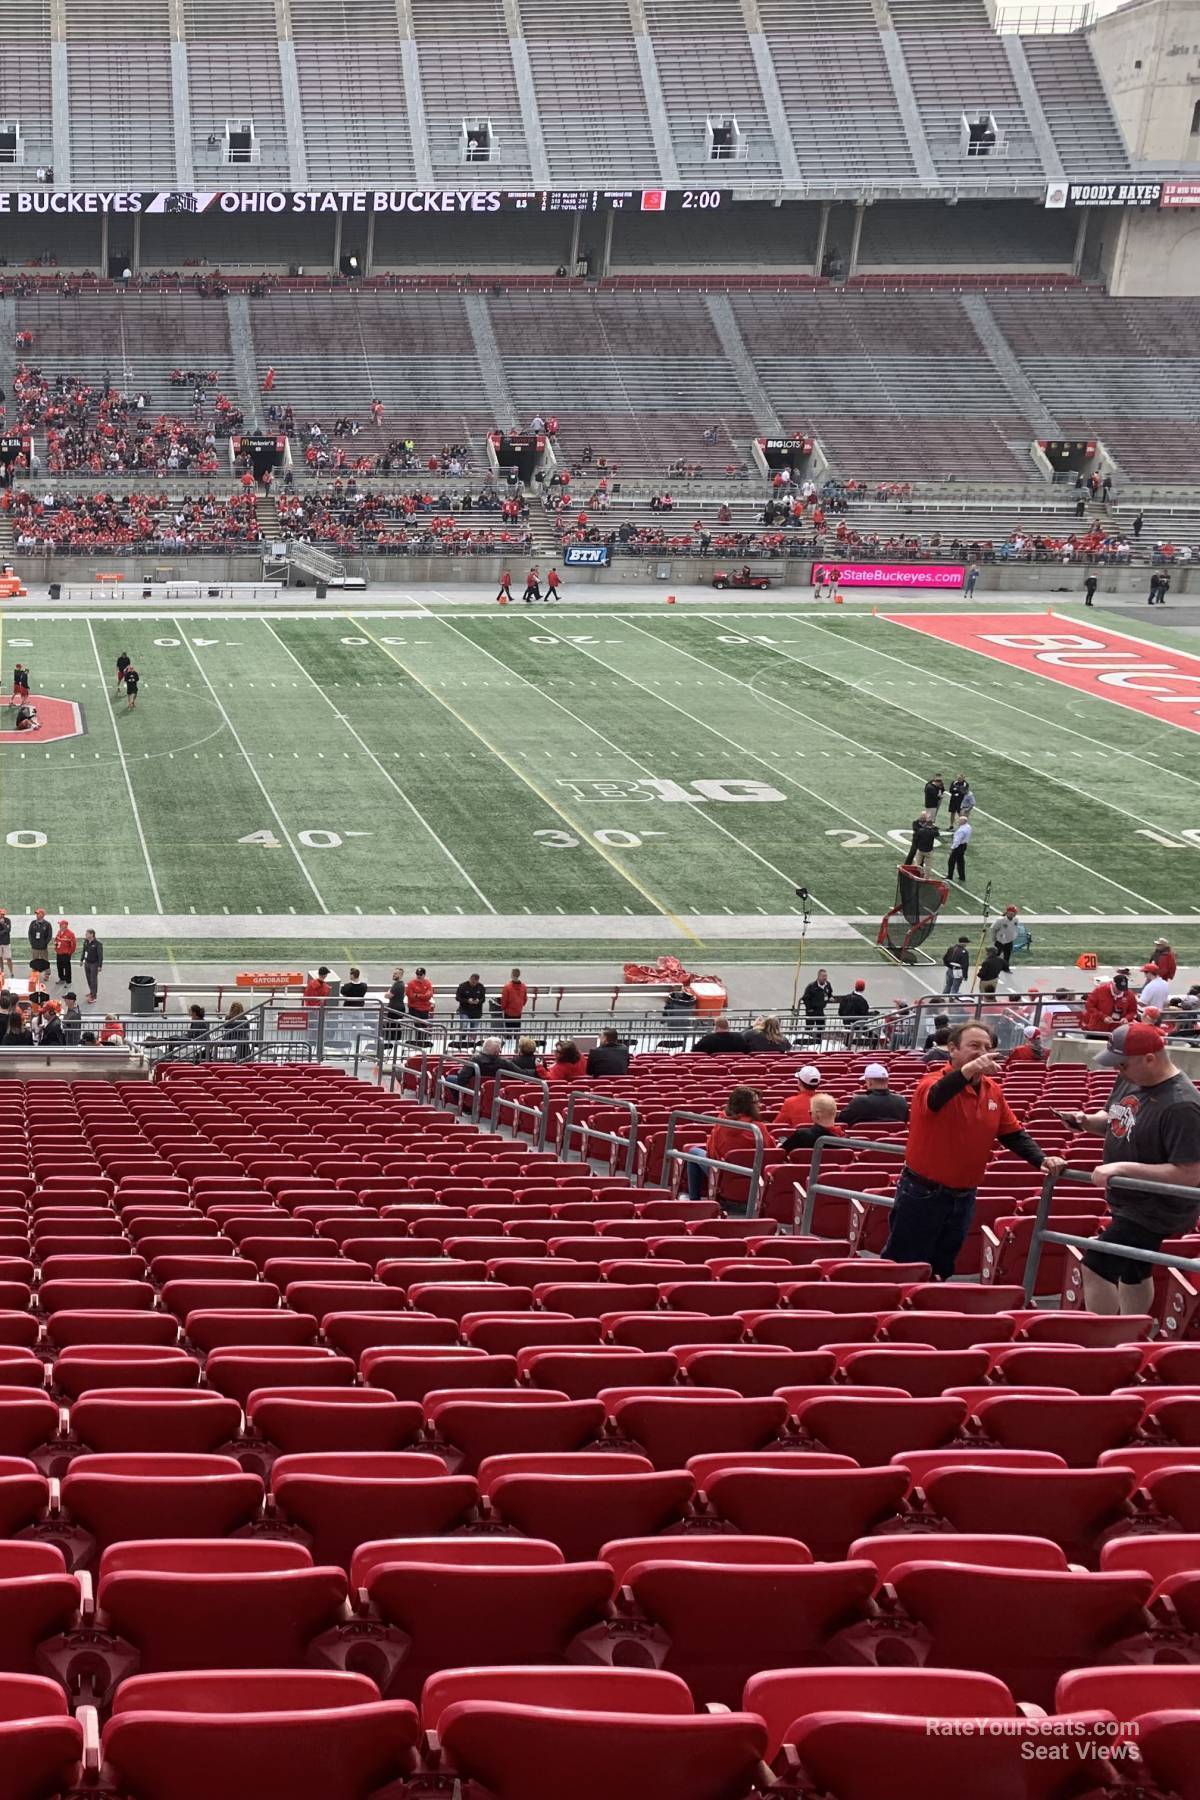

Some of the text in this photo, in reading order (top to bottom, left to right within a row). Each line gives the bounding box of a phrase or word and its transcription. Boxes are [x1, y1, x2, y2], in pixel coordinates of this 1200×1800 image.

[220, 192, 287, 212] OHIO
[292, 192, 366, 212] STATE
[373, 191, 500, 212] BUCKEYES
[681, 191, 720, 208] 2:00
[1071, 186, 1161, 200] WOODY HAYES
[18, 193, 142, 213] BUCKEYES
[569, 549, 601, 561] BTN
[237, 829, 344, 848] 40
[532, 829, 643, 848] 30
[1084, 955, 1097, 969] 20
